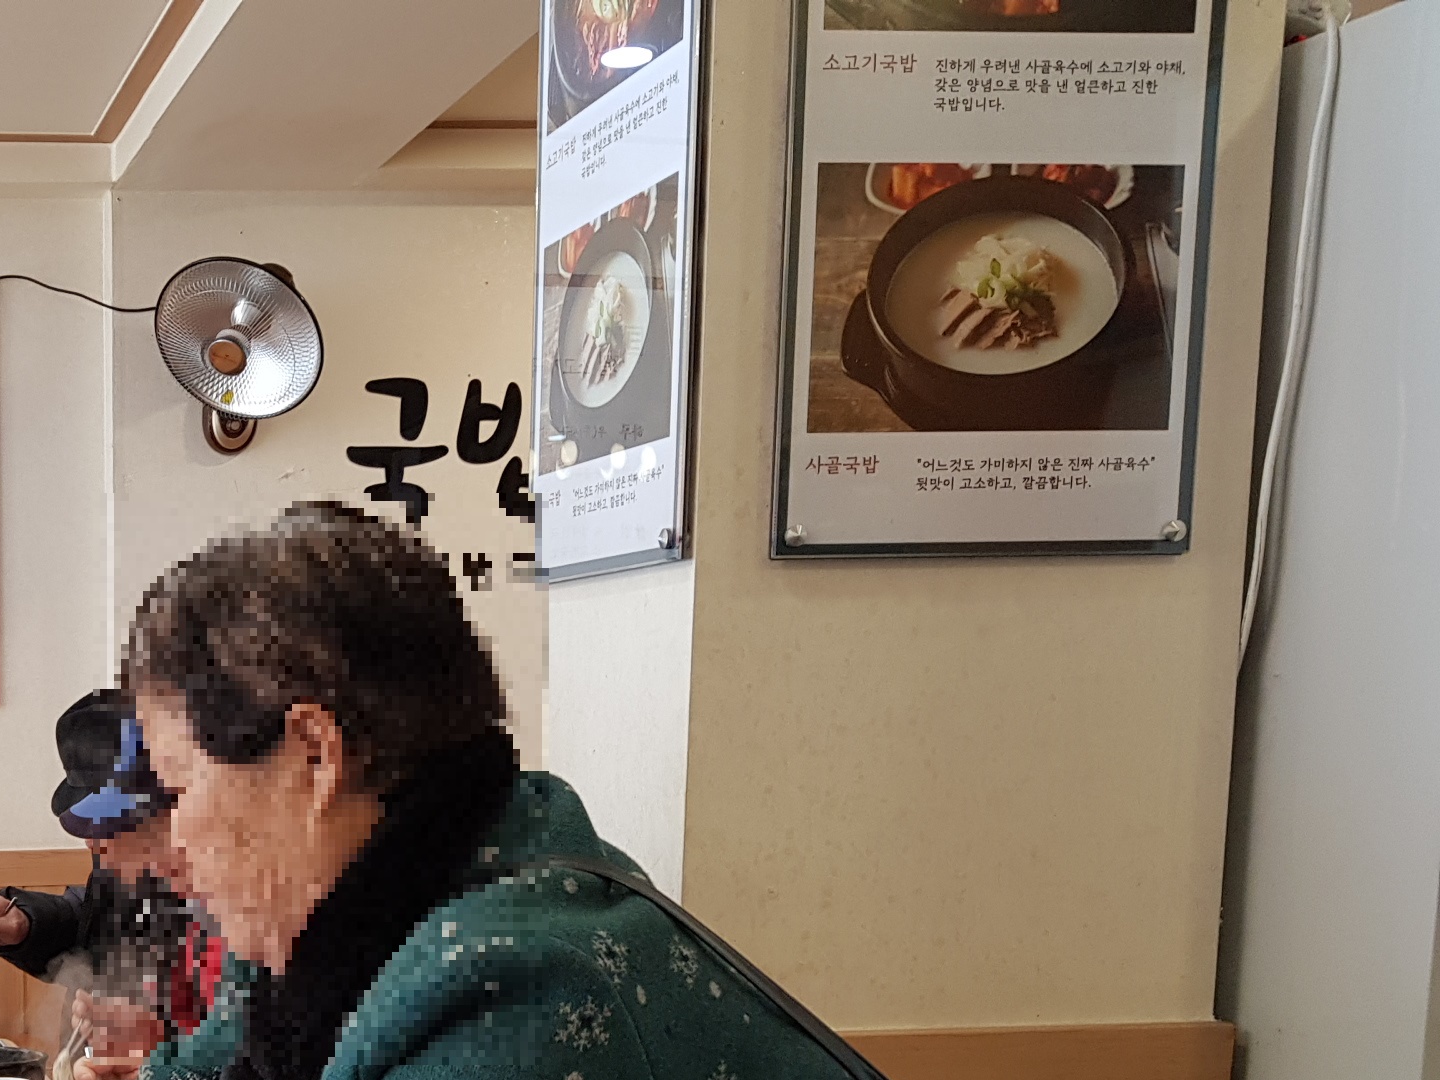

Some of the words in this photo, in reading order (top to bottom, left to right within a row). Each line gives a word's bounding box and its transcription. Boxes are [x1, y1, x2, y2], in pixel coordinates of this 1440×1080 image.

[822, 53, 917, 74] 소고기국밥
[935, 58, 976, 74] 진하게
[980, 59, 1021, 74] 우려낸
[1025, 59, 1093, 75] 사골육수에
[1097, 59, 1151, 75] 소고기와
[642, 79, 665, 105] 소고기와
[934, 78, 961, 93] 갖은
[966, 78, 1020, 93] 양념으로
[1025, 78, 1051, 93] 맛을
[1056, 78, 1069, 94] 낸
[1073, 78, 1126, 94] 얼큰하고
[1131, 79, 1158, 94] 진한
[934, 97, 1005, 113] 국밥입니다.
[546, 136, 576, 170] 소고기국밥
[805, 455, 880, 475] 사골국밥
[979, 457, 1032, 472] 가미하지
[1037, 457, 1063, 472] 않은
[1068, 457, 1094, 472] 진짜
[916, 475, 955, 491] 뒷맛이
[960, 475, 1017, 491] 고소하고,
[1022, 475, 1092, 491] 깔끔합니다.
